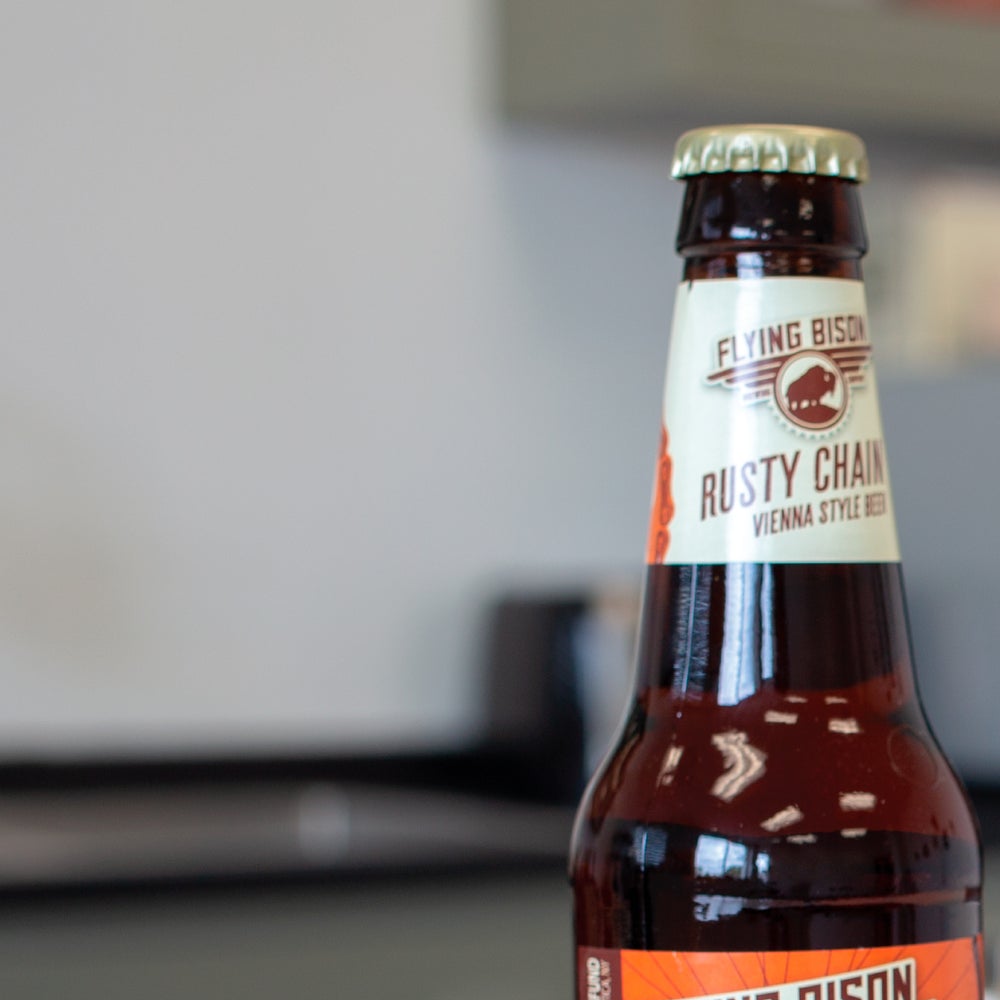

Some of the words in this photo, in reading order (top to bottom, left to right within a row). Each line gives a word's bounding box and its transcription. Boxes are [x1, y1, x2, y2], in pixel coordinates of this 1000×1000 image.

[718, 321, 802, 368] FLYING
[701, 451, 801, 521] RUSTY
[753, 505, 814, 538] VIENNA
[820, 495, 861, 525] STYLE
